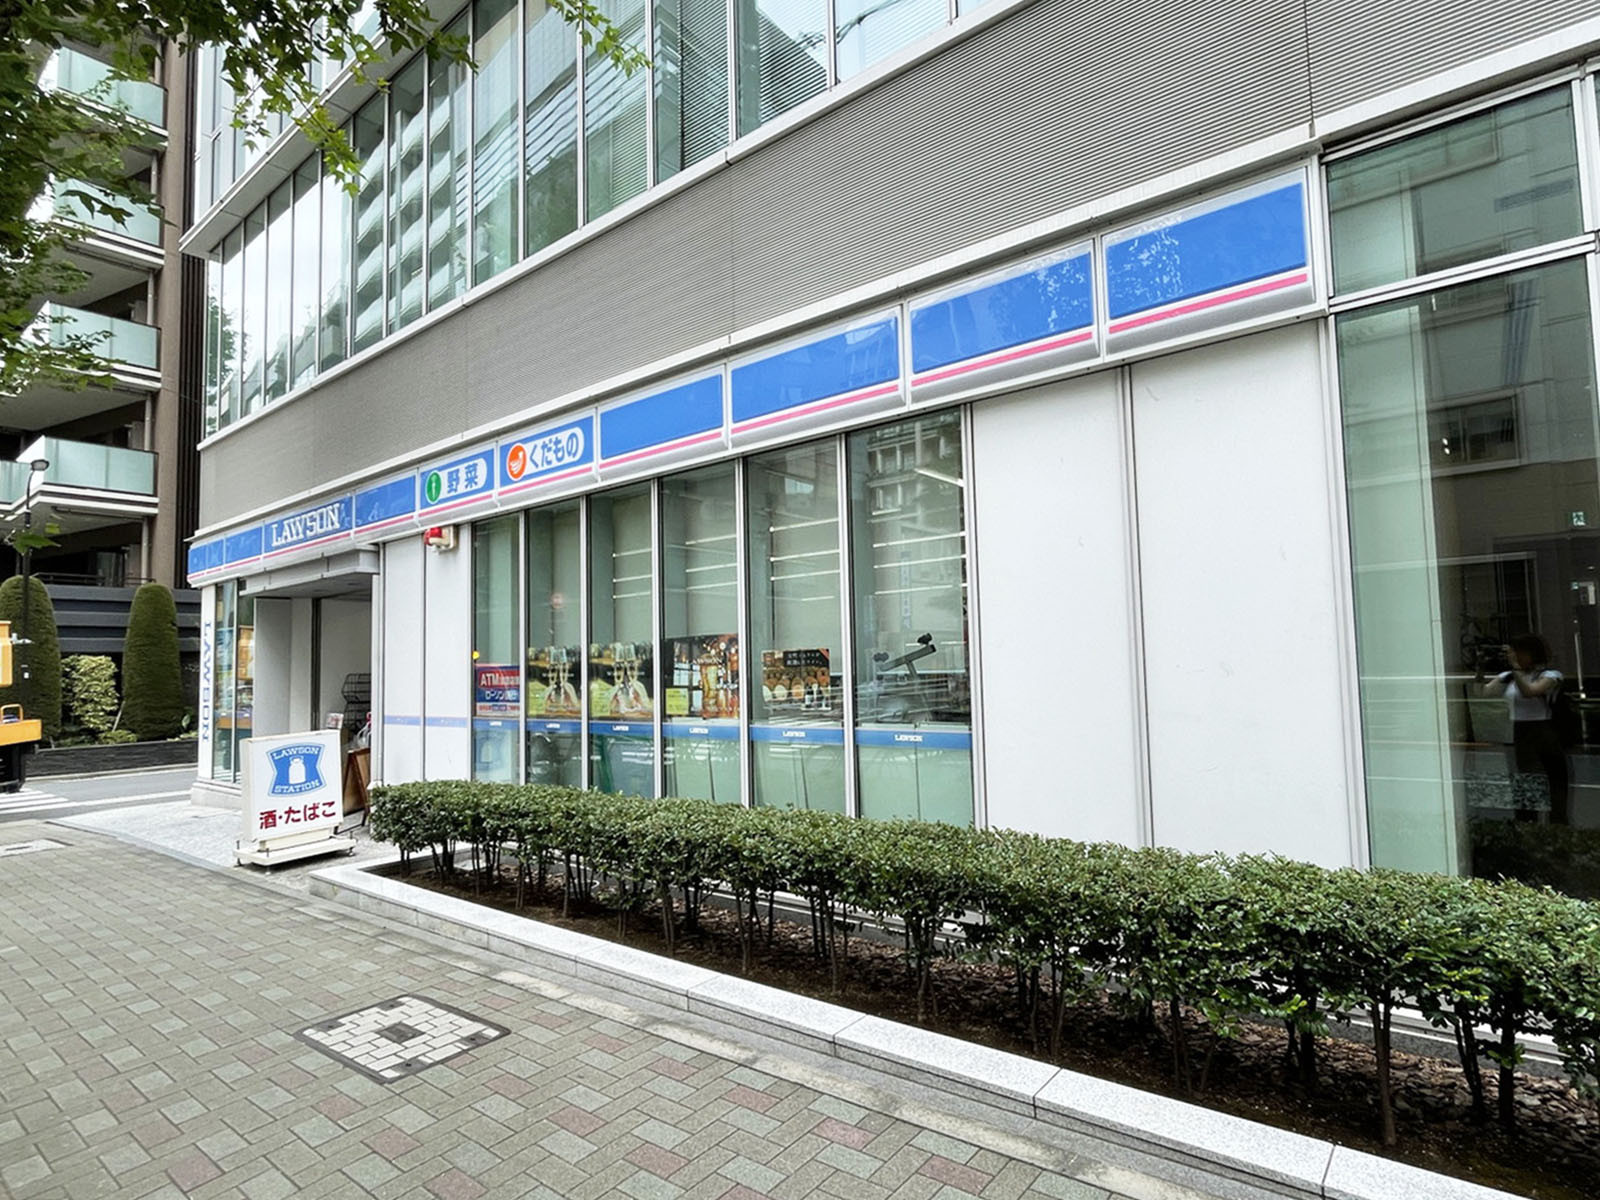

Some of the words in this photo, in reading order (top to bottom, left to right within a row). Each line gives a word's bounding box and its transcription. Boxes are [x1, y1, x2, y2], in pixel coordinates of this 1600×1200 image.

[529, 432, 580, 469] くだもの
[447, 463, 479, 494] 野菜
[271, 503, 341, 547] LAWSON
[203, 621, 212, 742] LAWSON
[273, 746, 320, 760] LAWSON
[274, 778, 321, 793] STATION
